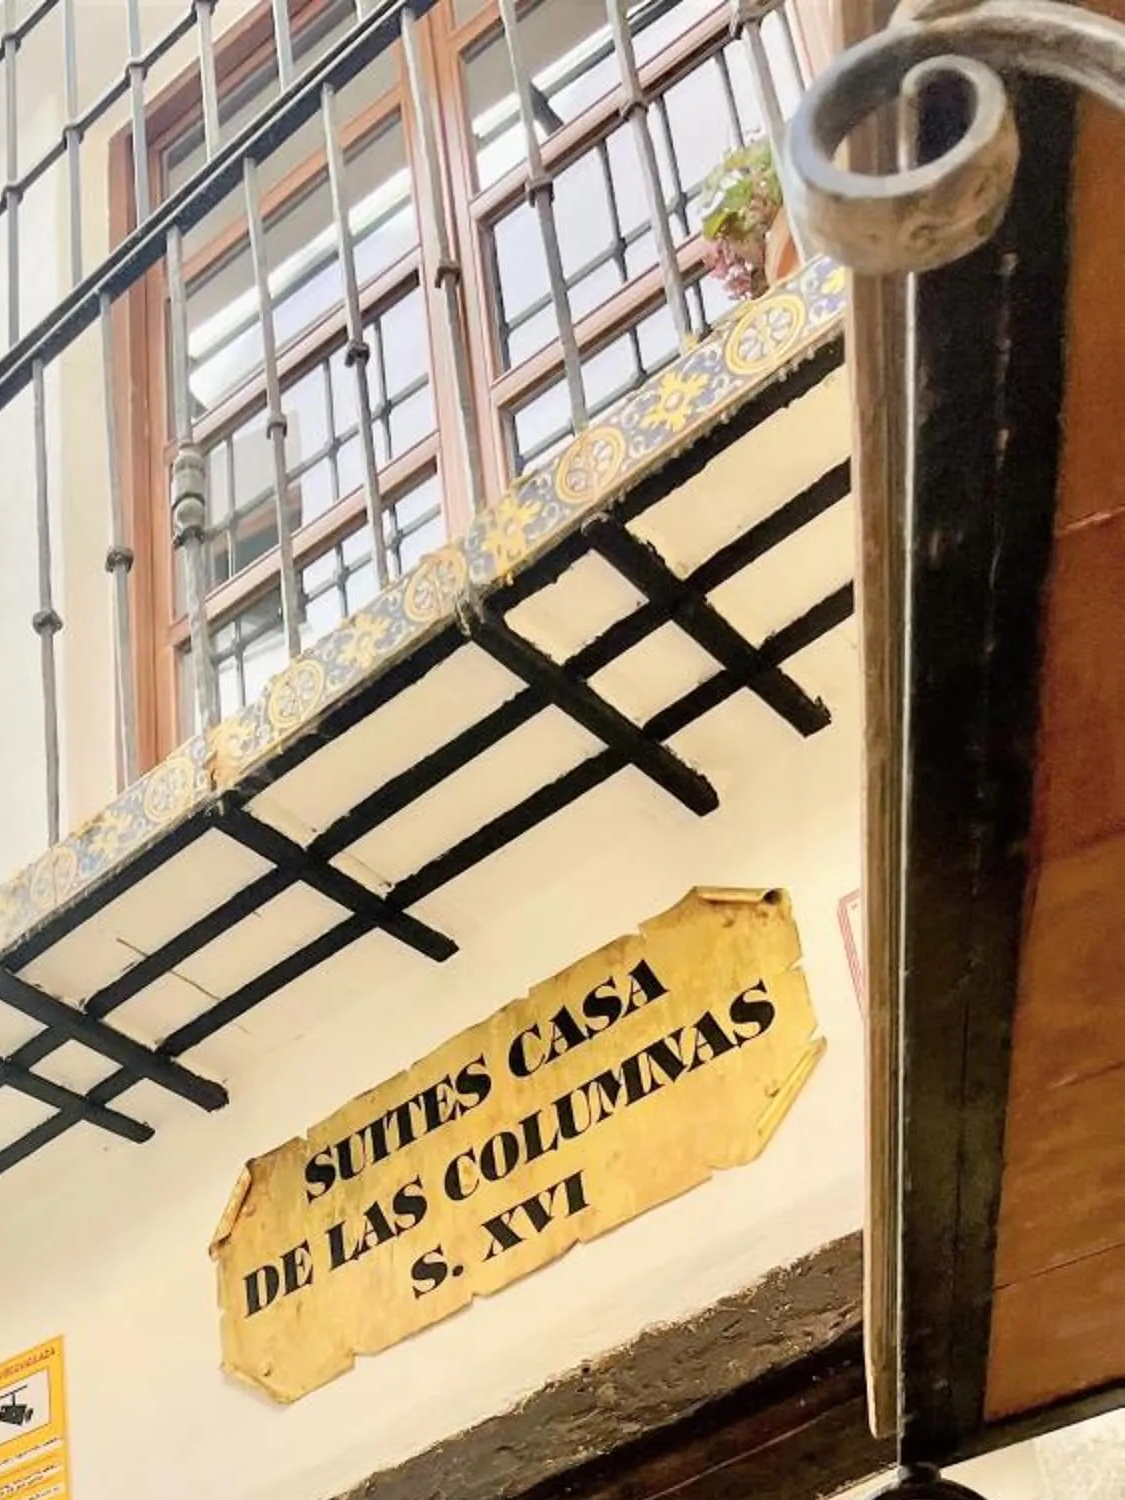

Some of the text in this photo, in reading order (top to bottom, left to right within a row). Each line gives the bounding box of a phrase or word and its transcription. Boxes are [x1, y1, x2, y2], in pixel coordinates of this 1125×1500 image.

[243, 979, 775, 1318] DE LAS COLUMNAS
[304, 959, 669, 1202] SUITES CASA
[412, 1170, 591, 1300] S. XVI
